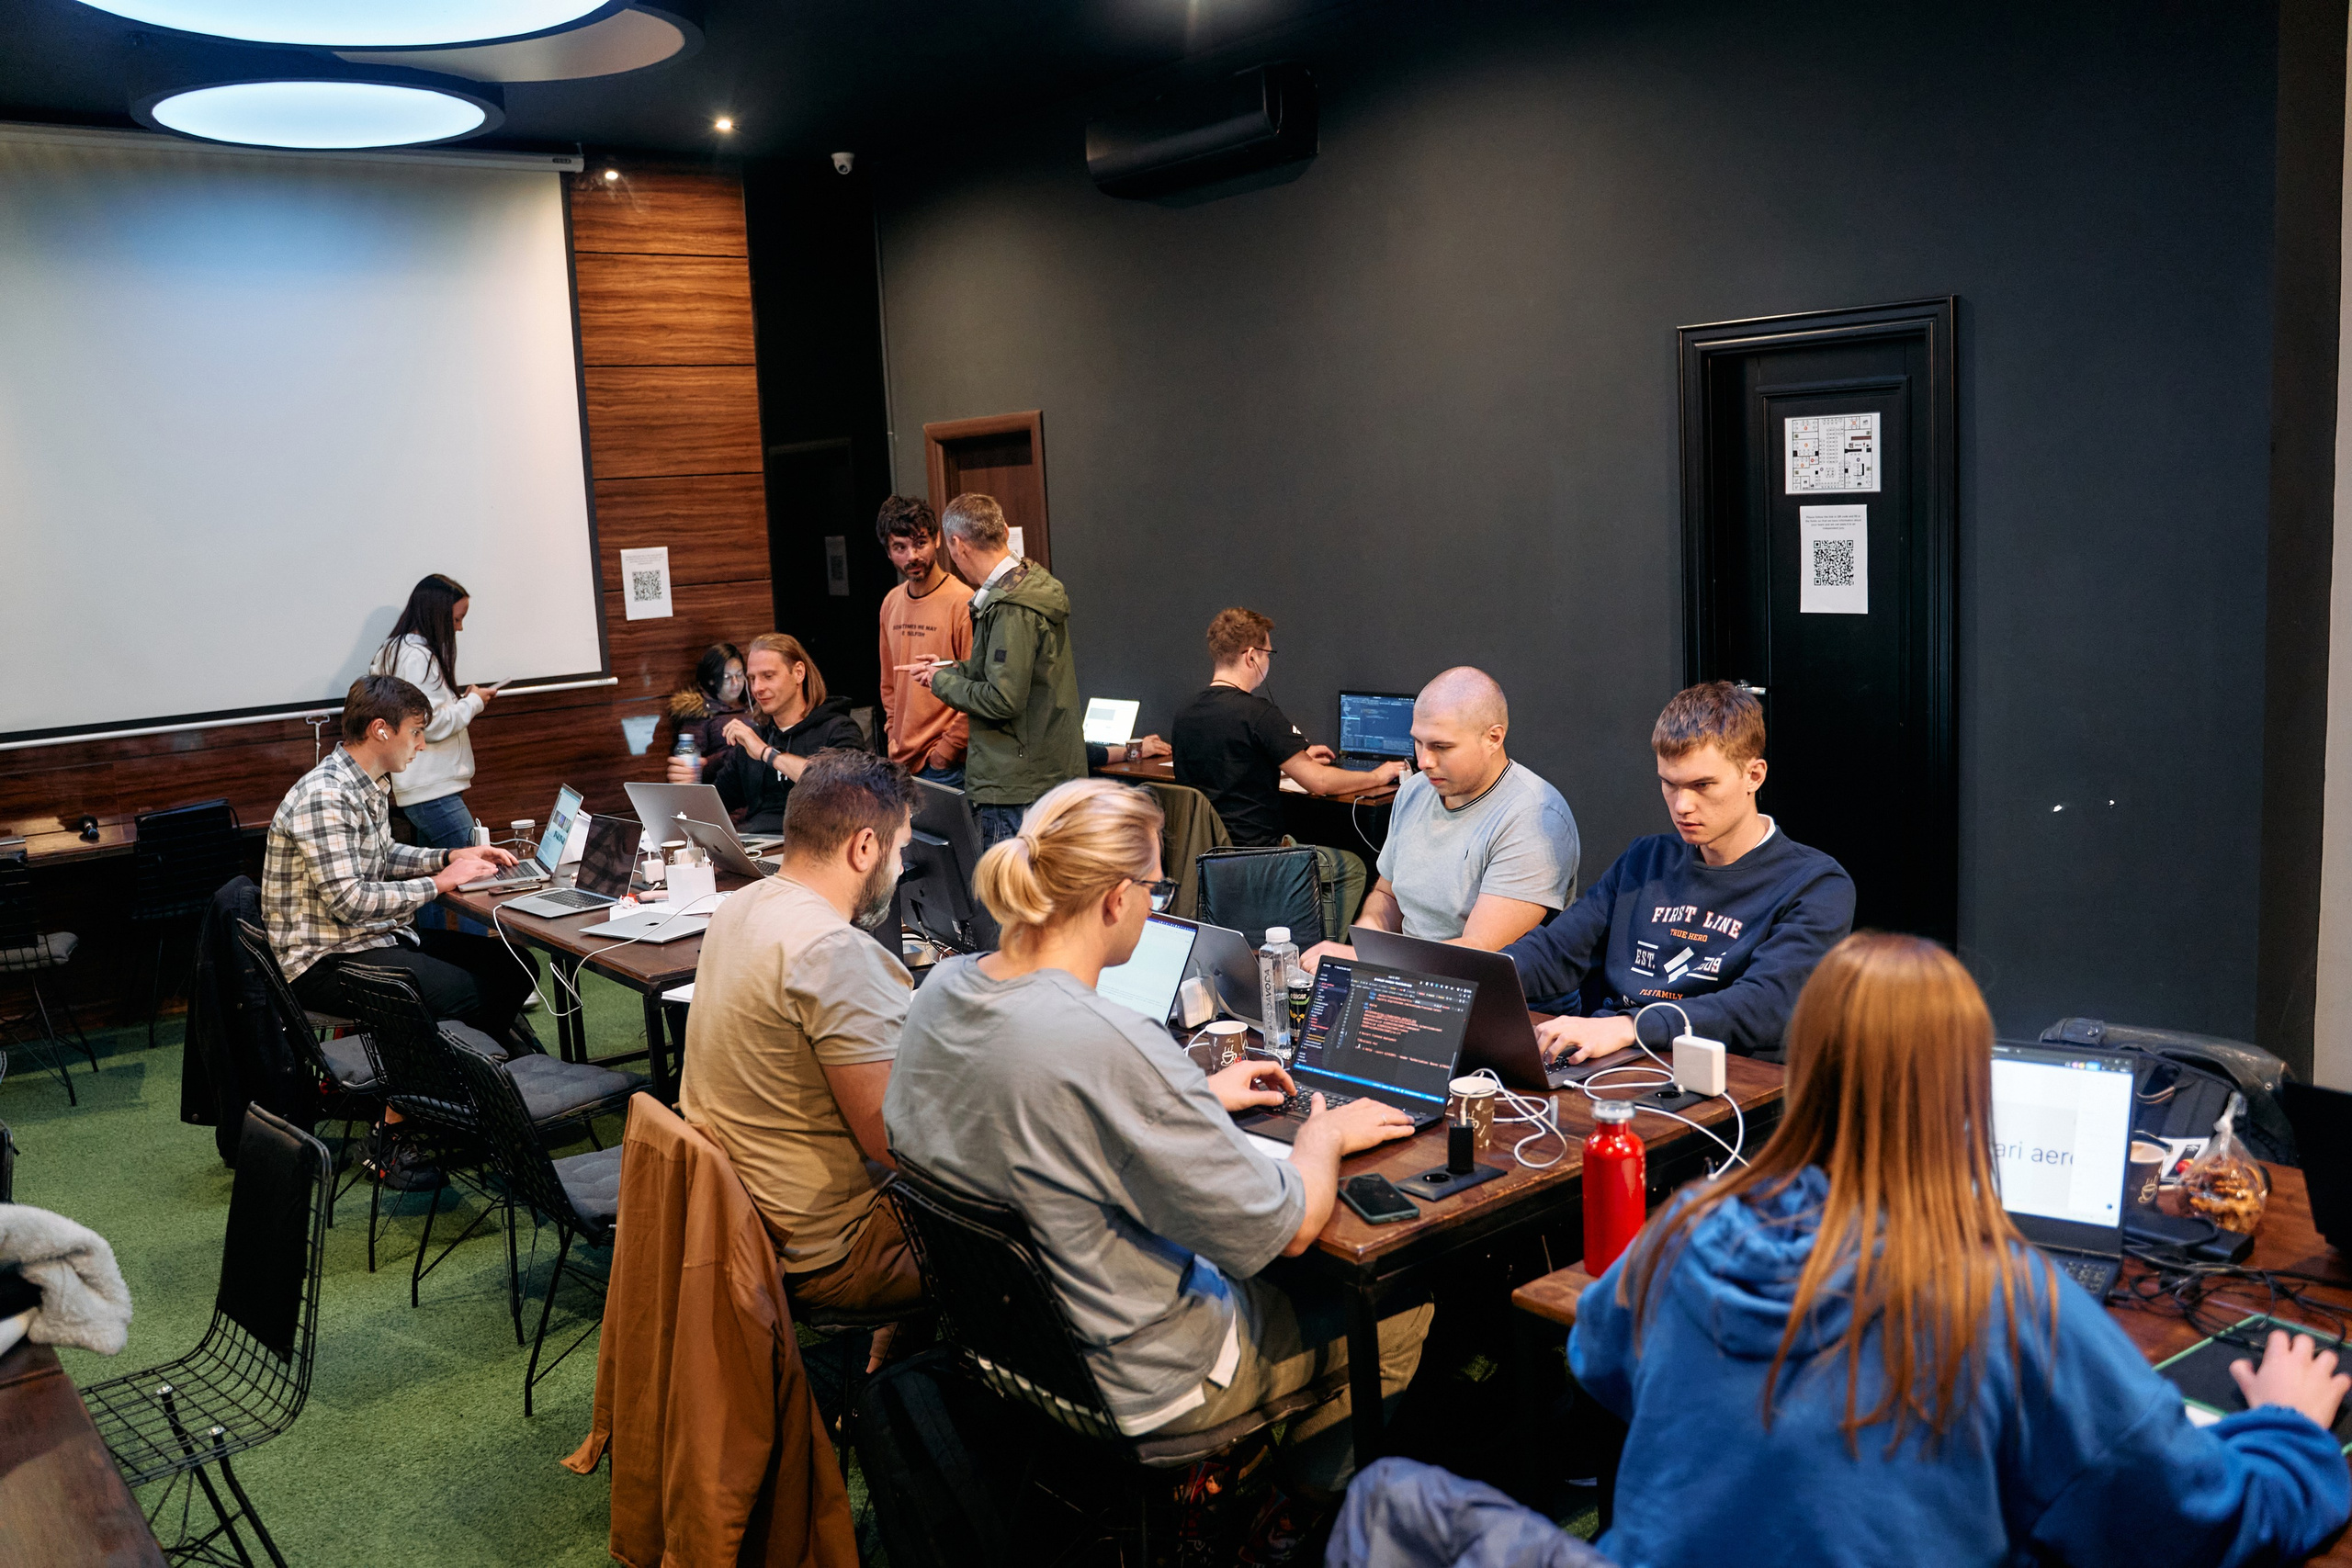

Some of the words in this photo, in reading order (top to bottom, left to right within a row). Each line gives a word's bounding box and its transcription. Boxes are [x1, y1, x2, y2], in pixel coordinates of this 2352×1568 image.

[1651, 905, 1698, 923] FIRST
[1702, 910, 1744, 940] LINE
[1669, 928, 1688, 940] TRUE
[1688, 931, 1708, 942] HERO
[1634, 948, 1656, 969] EST.
[1652, 989, 1683, 1000] FAMILY
